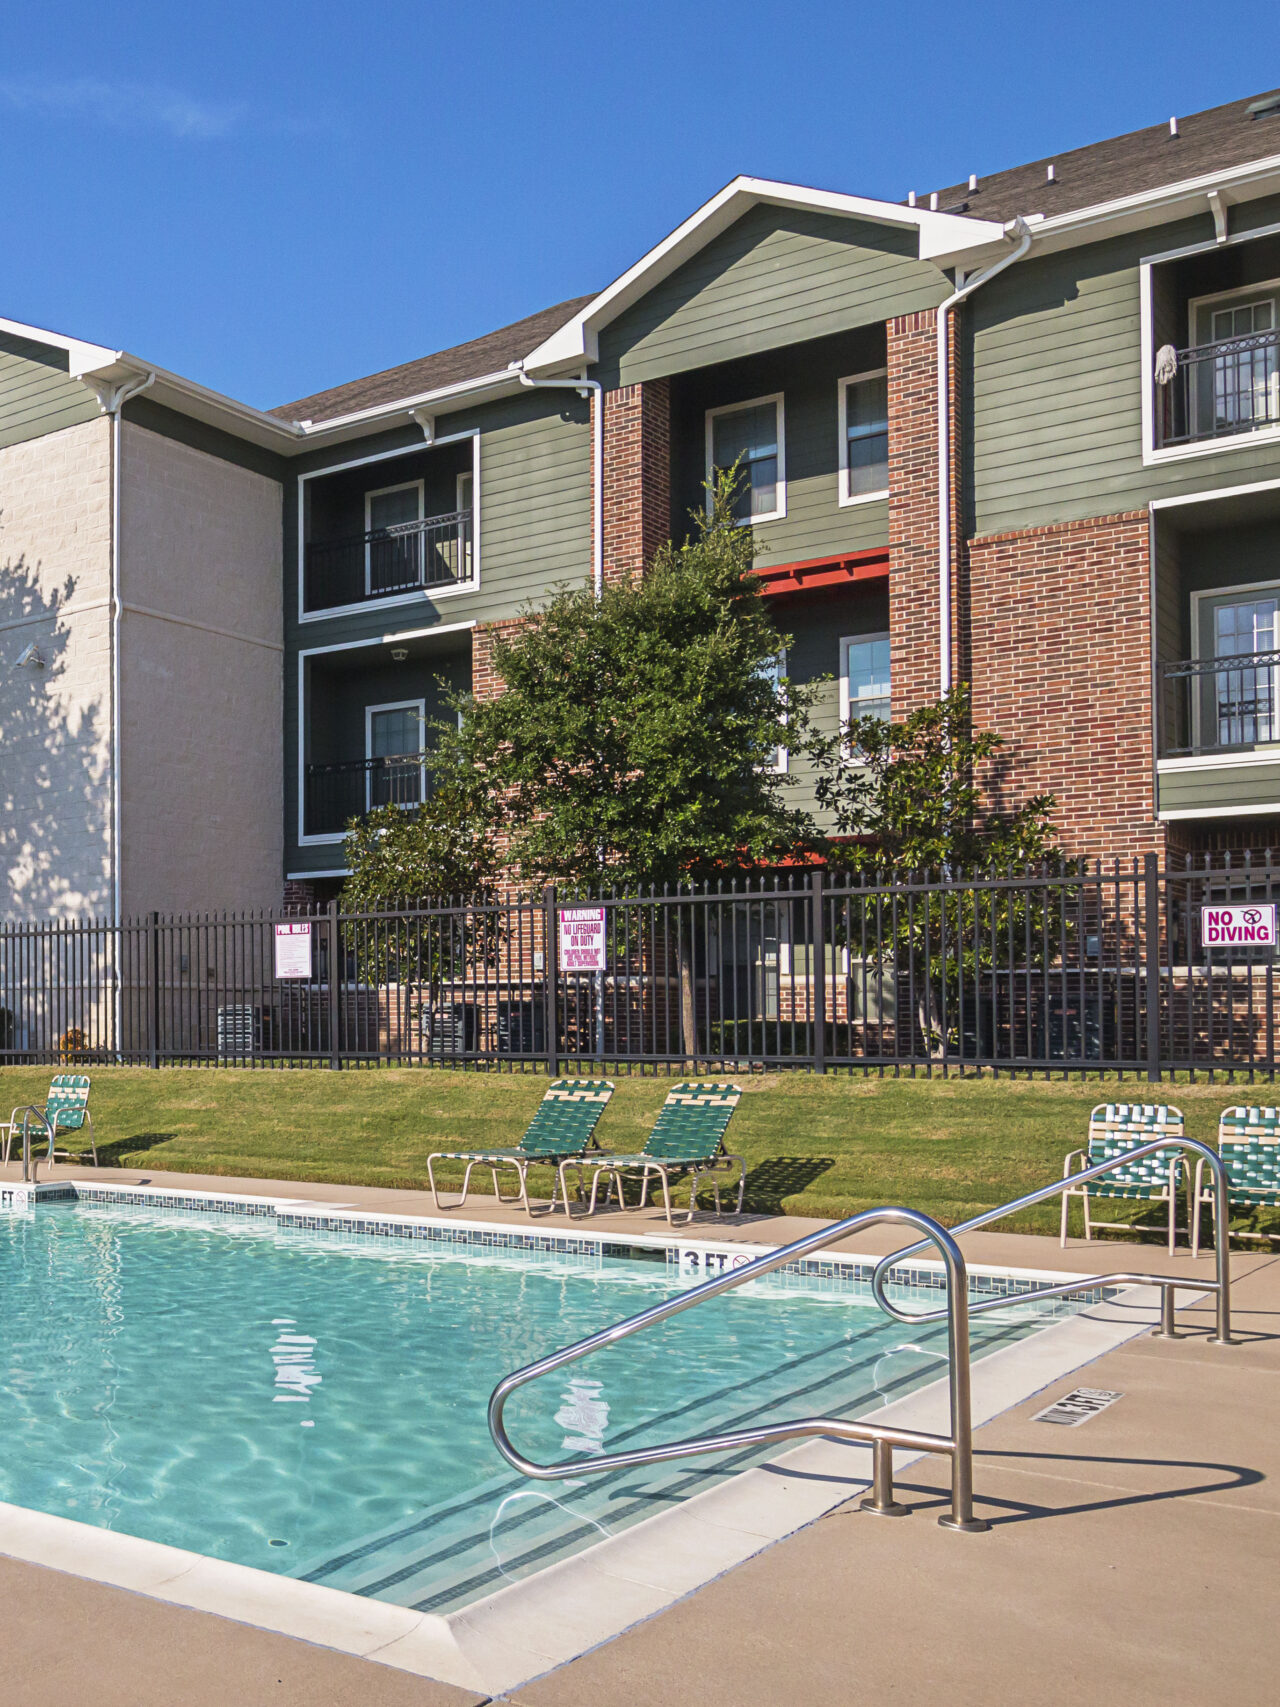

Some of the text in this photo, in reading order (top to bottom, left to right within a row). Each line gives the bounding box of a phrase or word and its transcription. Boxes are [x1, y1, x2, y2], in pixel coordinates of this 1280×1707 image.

[564, 909, 601, 921] WARNING
[1208, 911, 1233, 926] NO
[564, 923, 601, 935] NO LIFEGUARD
[1208, 926, 1269, 942] DIVING
[571, 935, 594, 947] ON DUTY
[2, 1191, 14, 1201] FT
[684, 1251, 728, 1269] 3 FT
